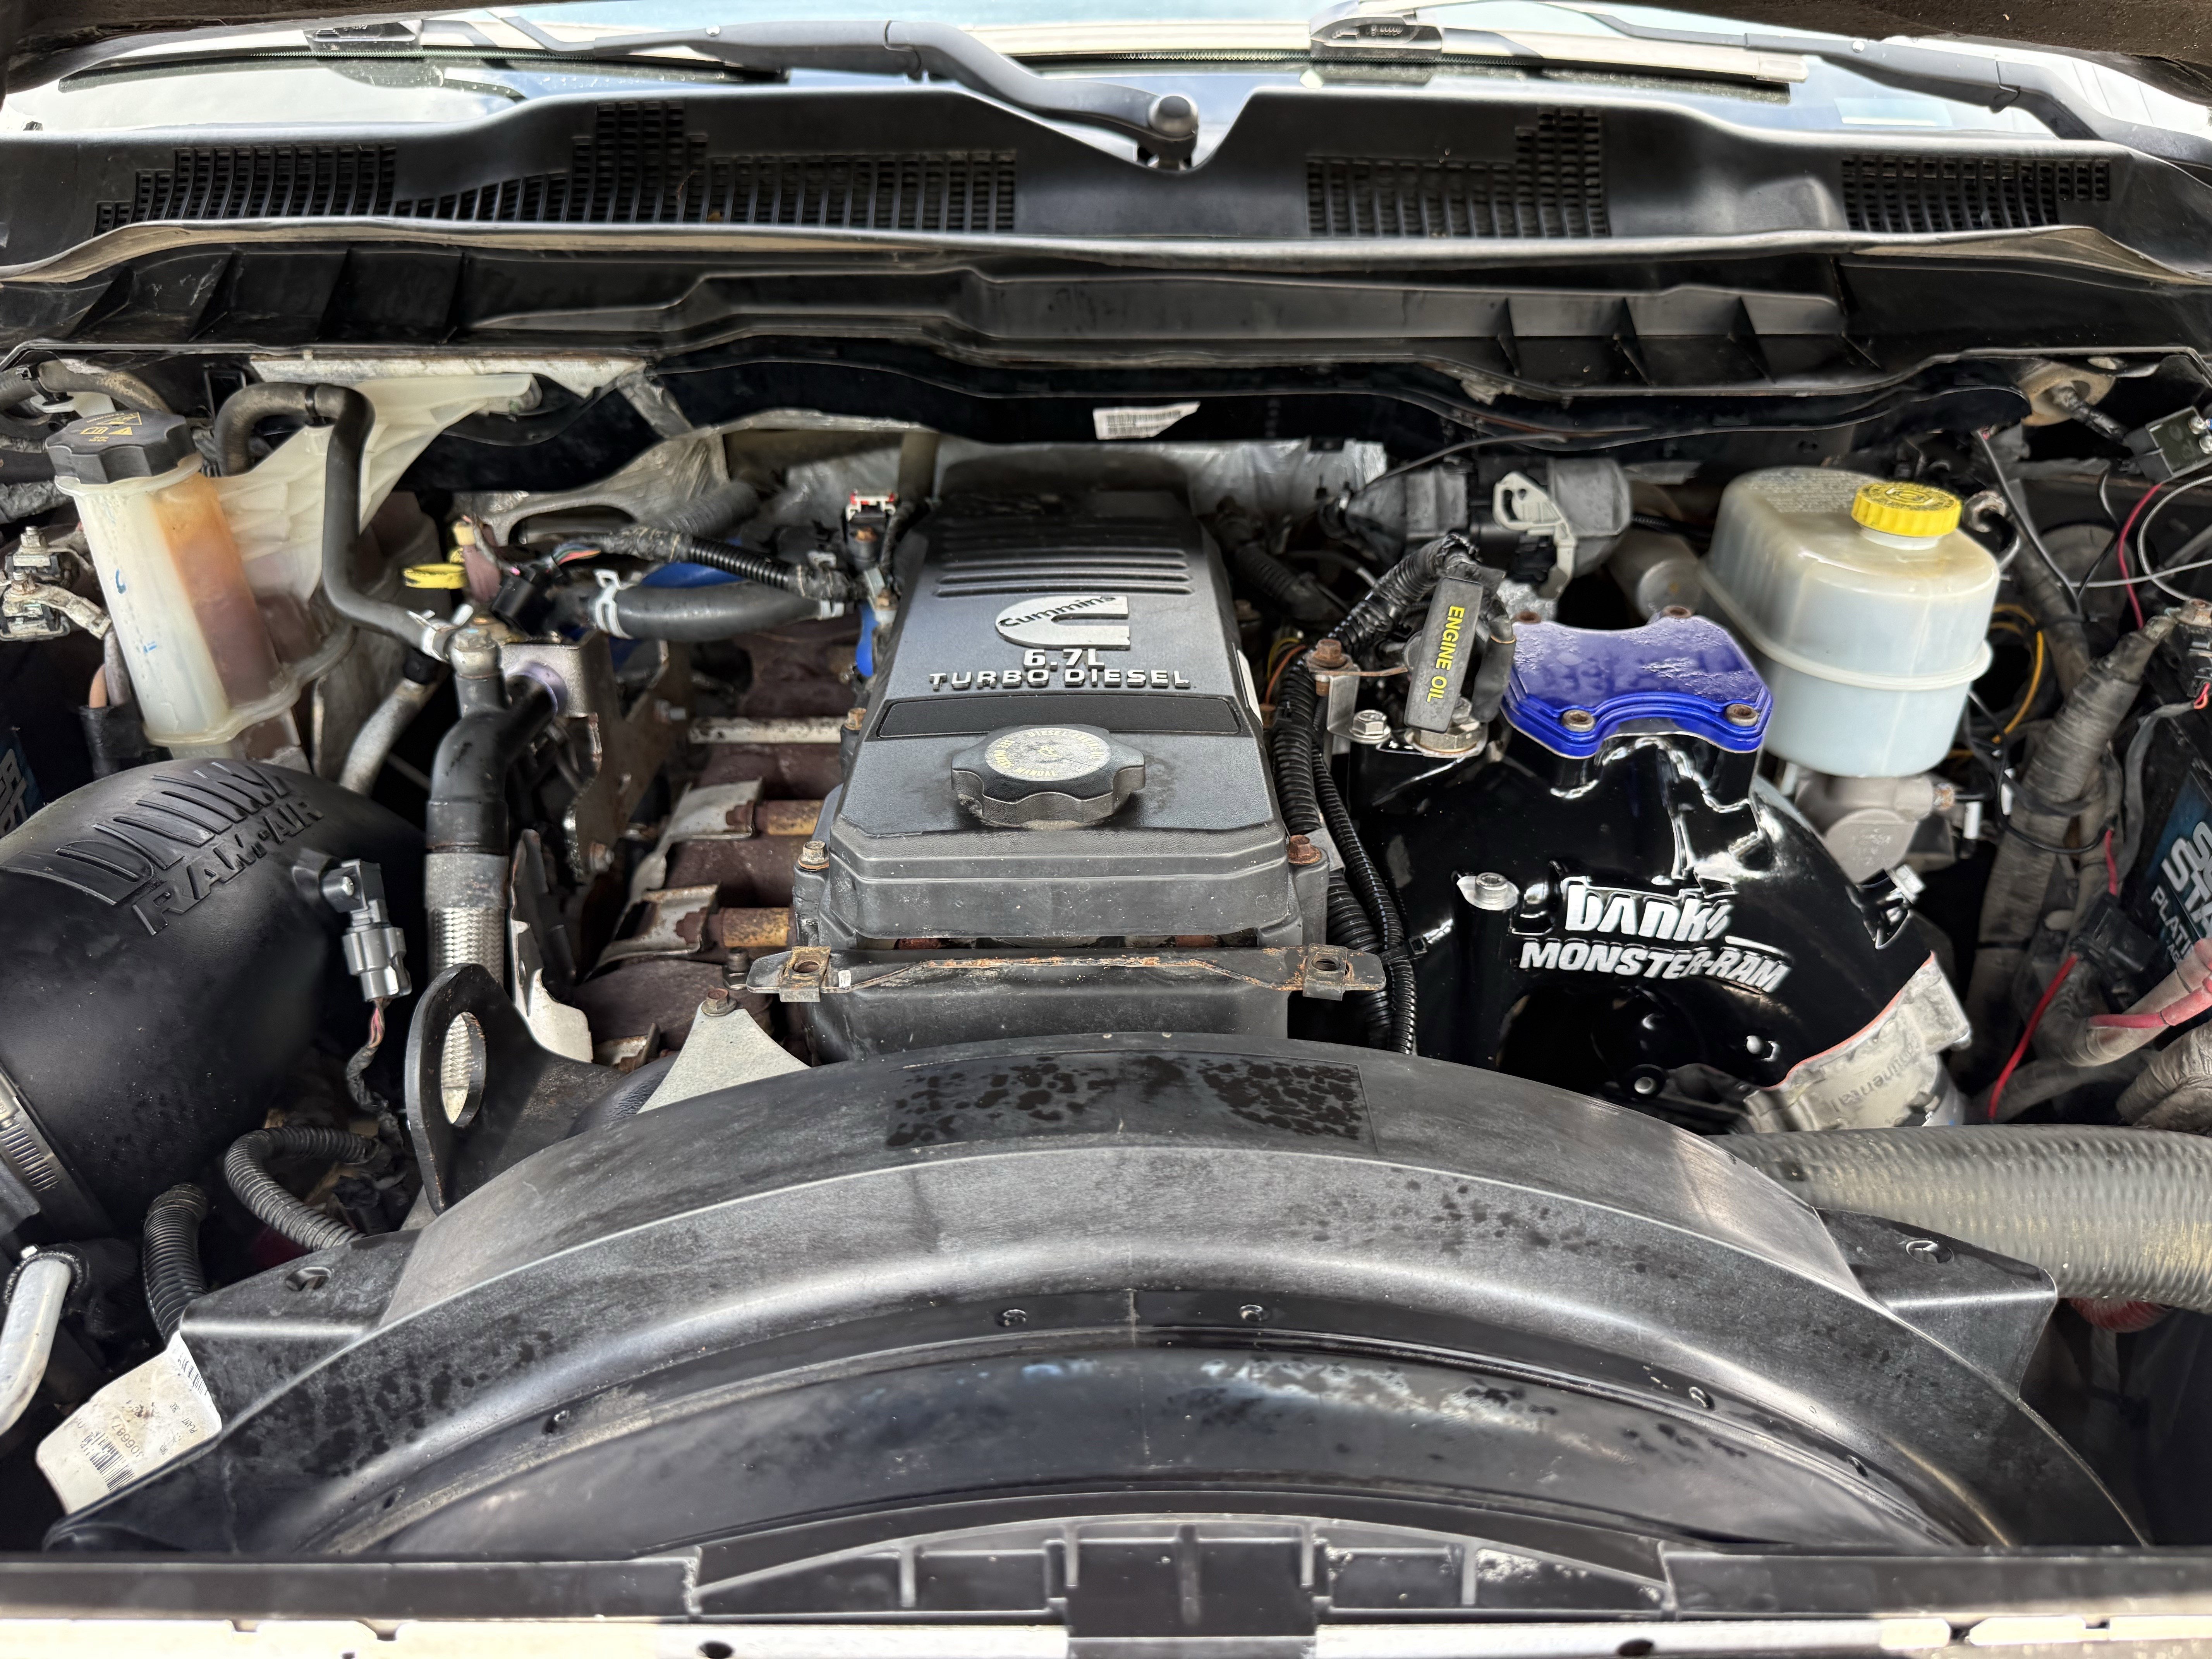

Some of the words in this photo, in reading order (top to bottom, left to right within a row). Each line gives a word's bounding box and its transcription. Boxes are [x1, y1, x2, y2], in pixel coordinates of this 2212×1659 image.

[998, 597, 1116, 627] Cummins
[1435, 606, 1465, 671] ENGINE
[1024, 649, 1105, 670] 6.7L
[929, 669, 1049, 690] TURBO
[1065, 669, 1191, 688] DIESEL
[1426, 675, 1448, 703] OIL
[1027, 730, 1068, 738] DIESEL
[1014, 766, 1058, 777] MANUAL
[2150, 885, 2194, 960] PLATI
[1519, 942, 1790, 993] MONSTER-RAM
